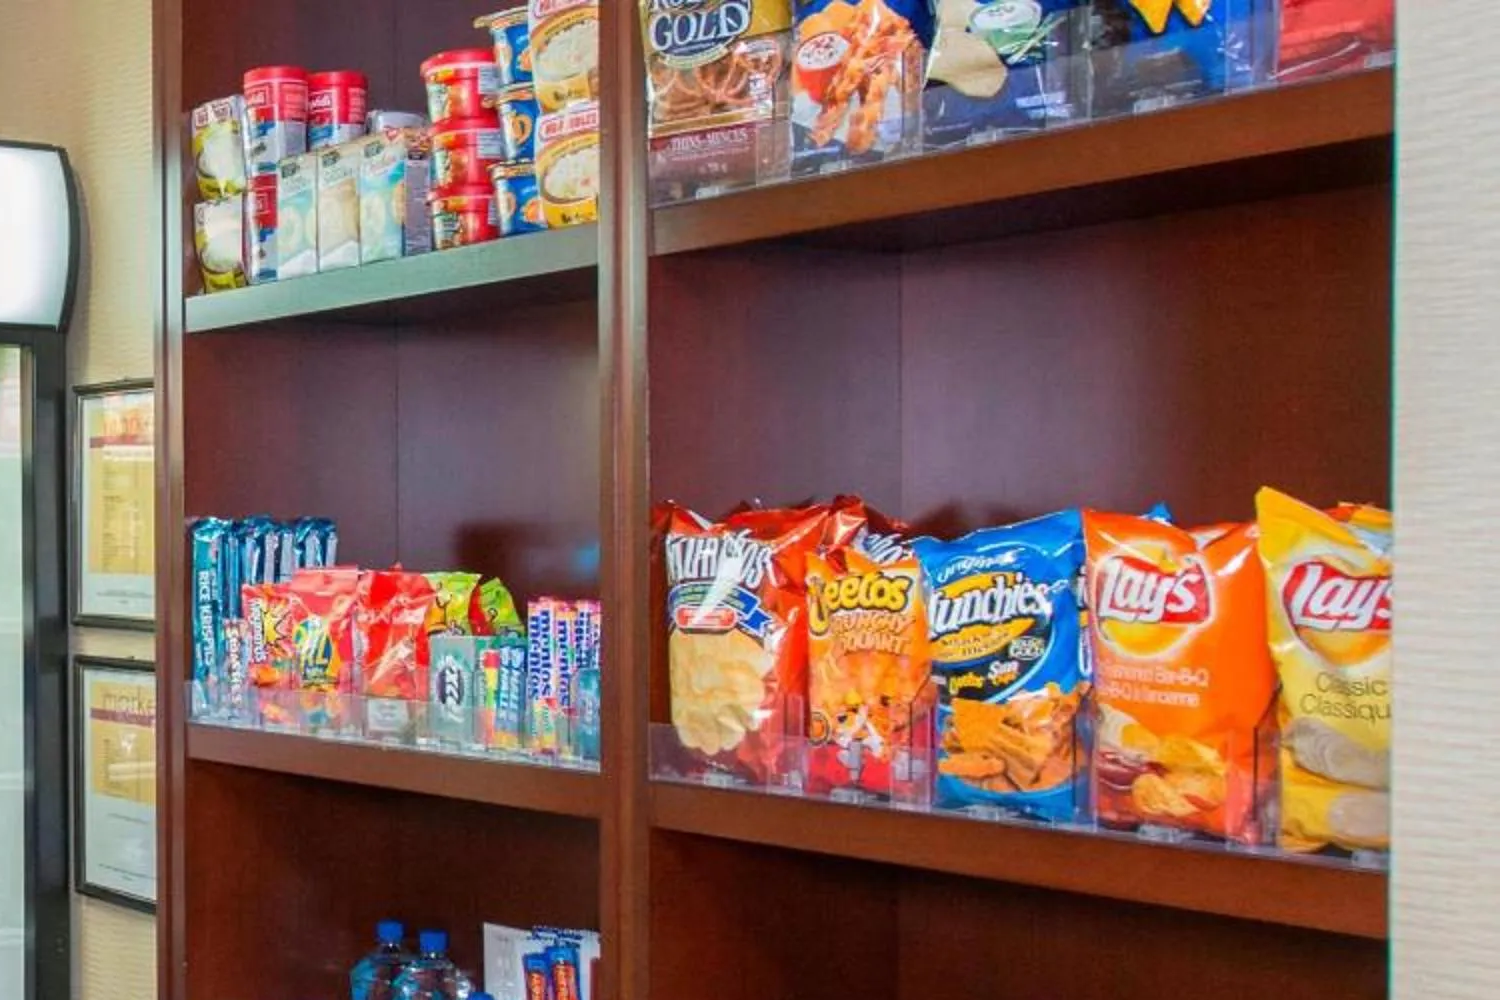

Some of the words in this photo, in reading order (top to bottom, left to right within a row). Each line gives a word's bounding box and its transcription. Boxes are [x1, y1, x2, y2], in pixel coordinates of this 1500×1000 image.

[651, 2, 750, 51] GOLD
[1099, 557, 1200, 624] Lay's
[540, 610, 551, 695] mentos
